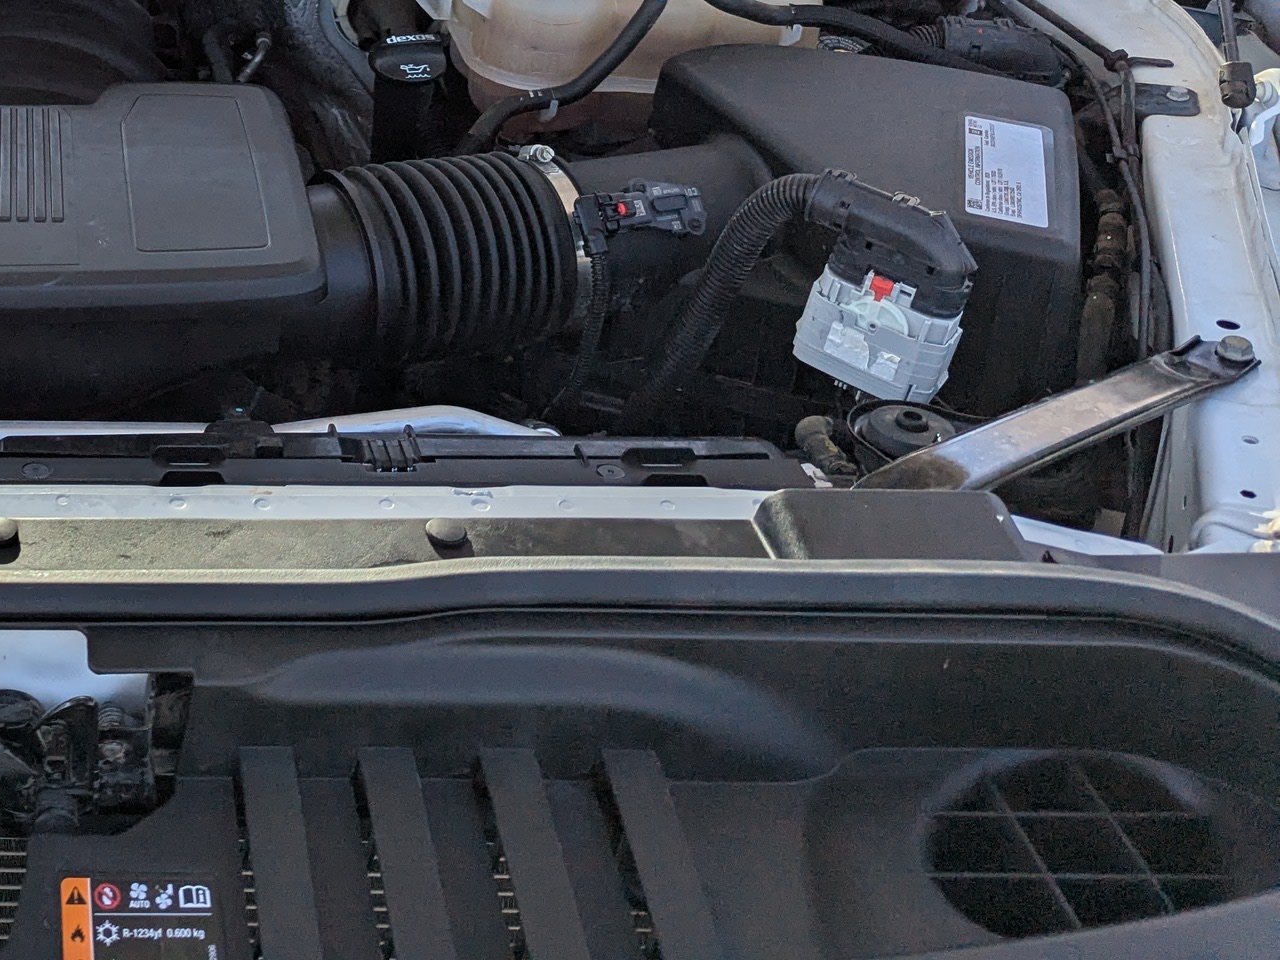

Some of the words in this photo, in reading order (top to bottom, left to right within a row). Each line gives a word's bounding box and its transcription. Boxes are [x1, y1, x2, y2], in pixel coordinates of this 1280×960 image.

[386, 34, 436, 44] dexos
[129, 900, 150, 909] AUTO
[122, 927, 162, 939] R-1234yf
[166, 928, 192, 938] 0.600
[192, 928, 206, 940] kg
